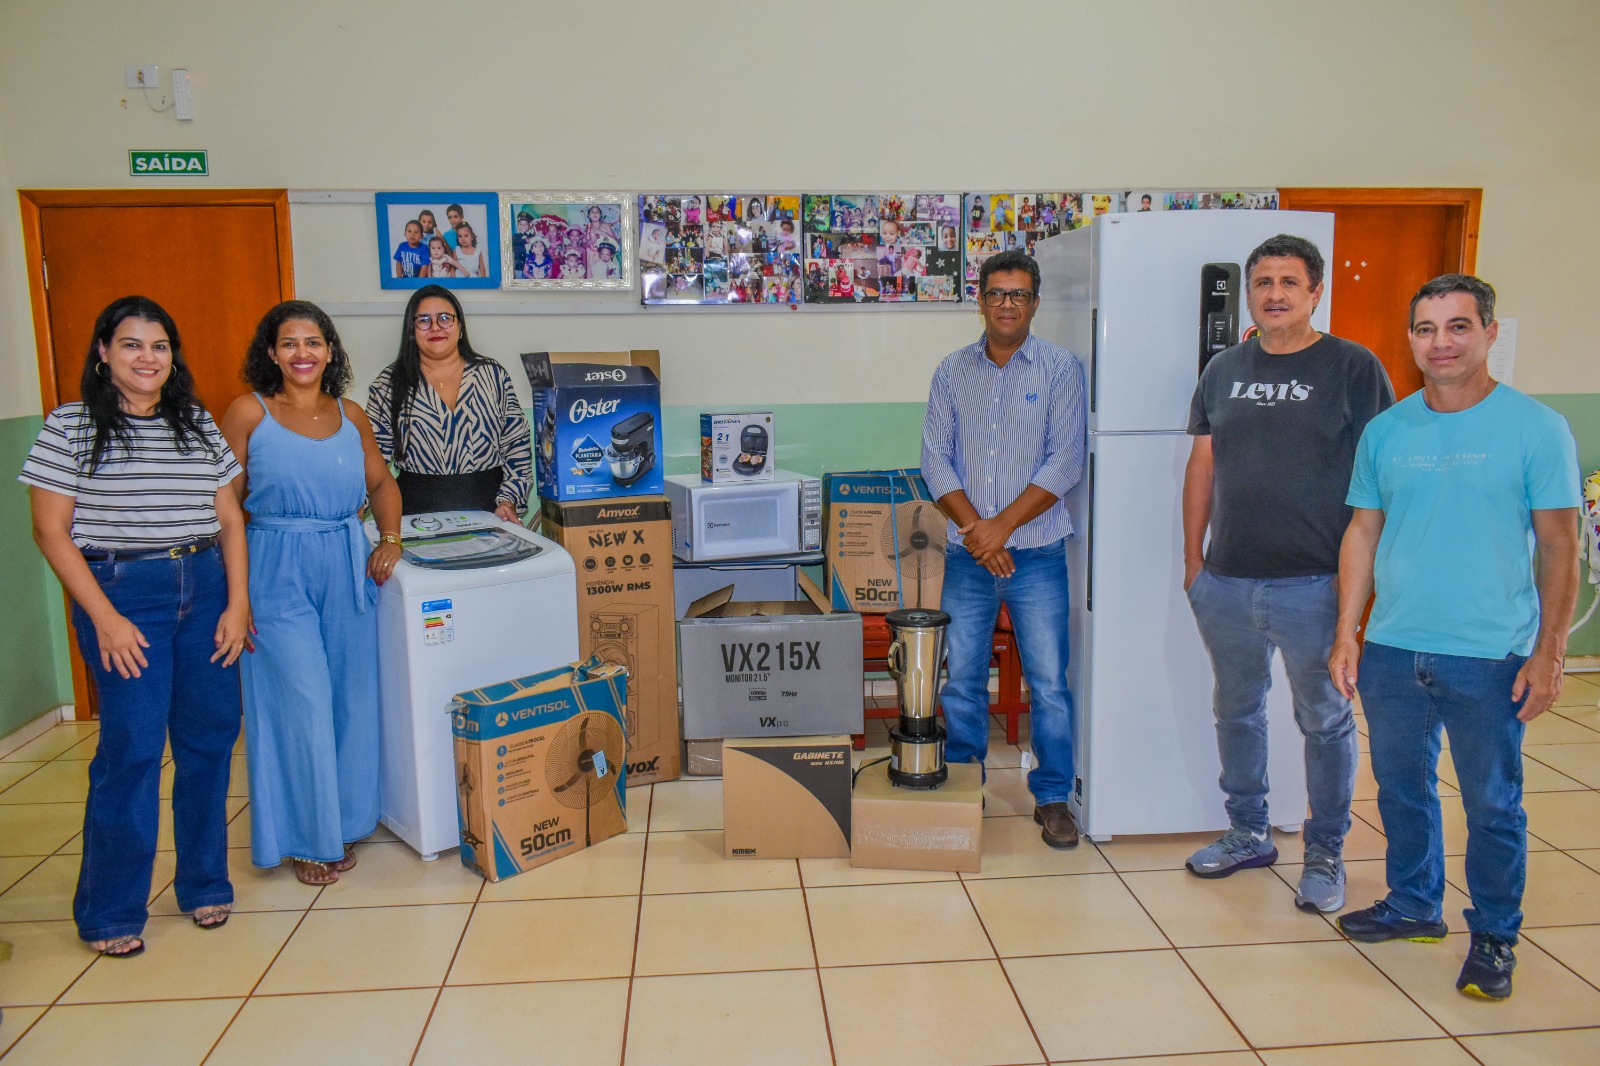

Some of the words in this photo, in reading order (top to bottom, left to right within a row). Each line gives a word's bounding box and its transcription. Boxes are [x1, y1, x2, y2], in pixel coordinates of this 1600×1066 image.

[136, 154, 203, 171] SAÍDA
[584, 368, 627, 382] Oster
[569, 398, 621, 424] Oster
[853, 485, 906, 494] VENTISOL
[596, 505, 641, 519] Amvox
[588, 530, 628, 549] NEW
[632, 529, 645, 545] X
[586, 579, 615, 587] POTÊNCIA
[586, 584, 624, 595] 1300W
[627, 581, 651, 592] RMS
[855, 588, 902, 601] 50cm
[720, 641, 821, 672] VX215X
[725, 674, 753, 683] MONITOR
[511, 700, 571, 721] VENTISOL
[793, 751, 844, 760] GABINETE
[534, 816, 560, 833] NEW
[520, 828, 571, 857] 50cm
